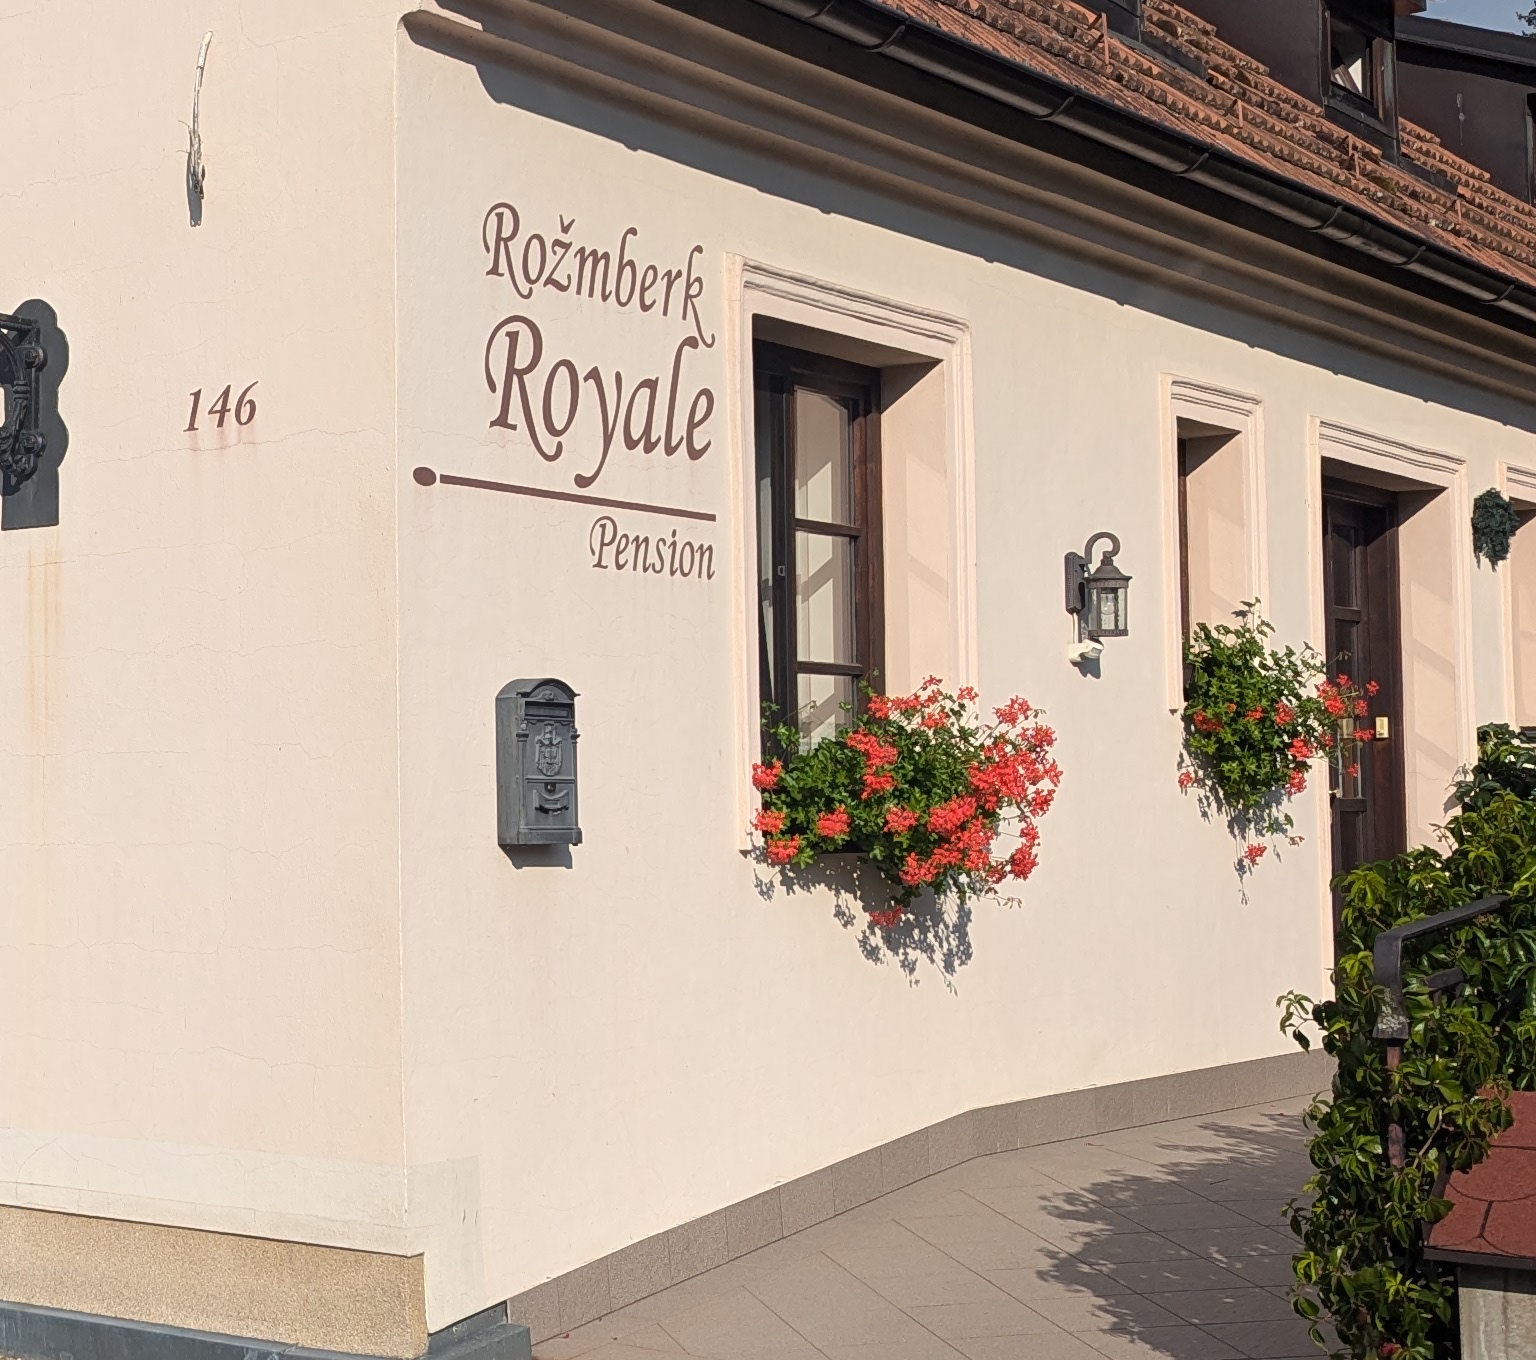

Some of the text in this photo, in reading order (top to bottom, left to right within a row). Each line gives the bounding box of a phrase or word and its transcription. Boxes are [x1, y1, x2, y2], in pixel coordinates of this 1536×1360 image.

[482, 201, 716, 349] Rožmberk
[182, 380, 259, 433] 146
[484, 314, 716, 489] Royale
[589, 515, 716, 581] Pension
